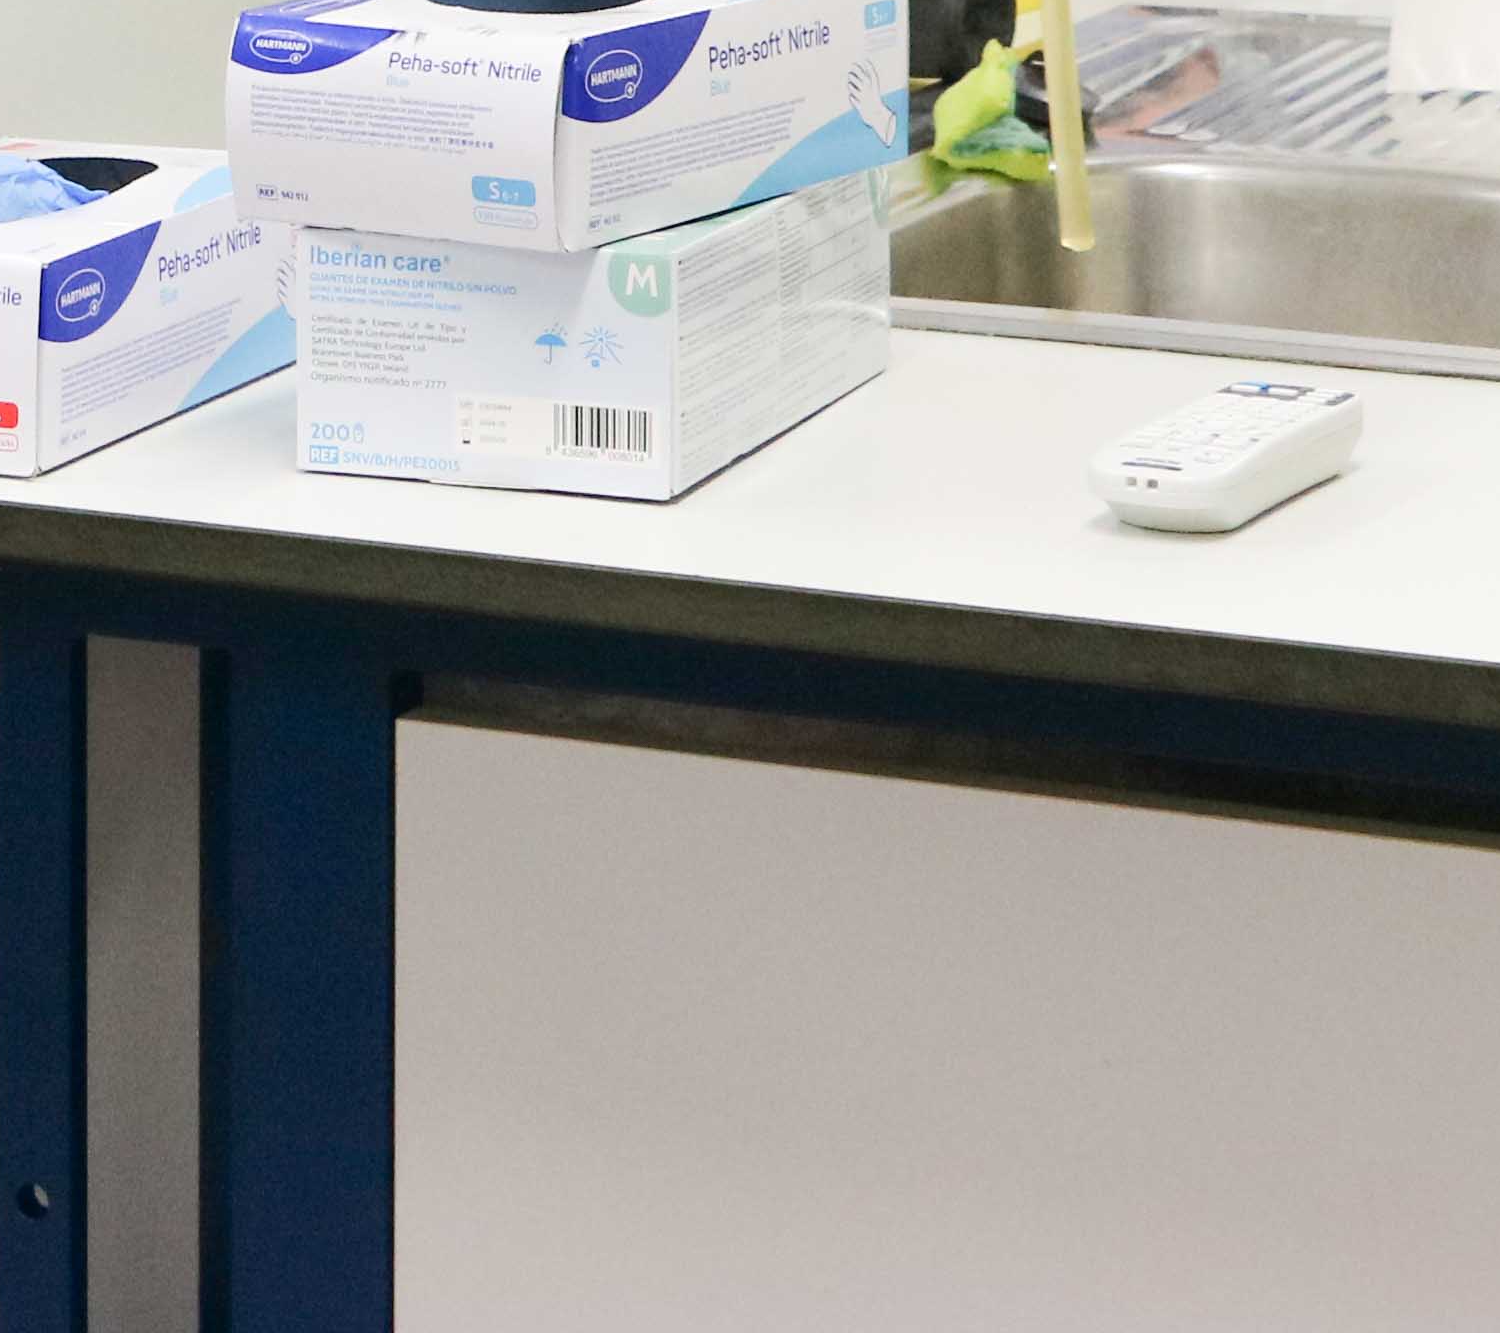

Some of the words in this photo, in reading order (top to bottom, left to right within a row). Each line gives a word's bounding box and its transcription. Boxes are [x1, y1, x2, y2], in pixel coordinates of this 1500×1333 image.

[256, 38, 307, 52] HARTMANN
[788, 21, 830, 52] Nitrile
[488, 60, 542, 83] Nitrile
[590, 64, 638, 87] HARTMANN
[488, 180, 501, 200] S
[226, 223, 262, 257] Nitrile
[310, 244, 386, 271] Iberian
[370, 277, 410, 287] EXAMEN
[625, 261, 658, 298] M
[60, 281, 101, 308] HARTMANN
[311, 371, 362, 383] Organismo
[311, 422, 350, 442] 200
[311, 446, 339, 463] REF
